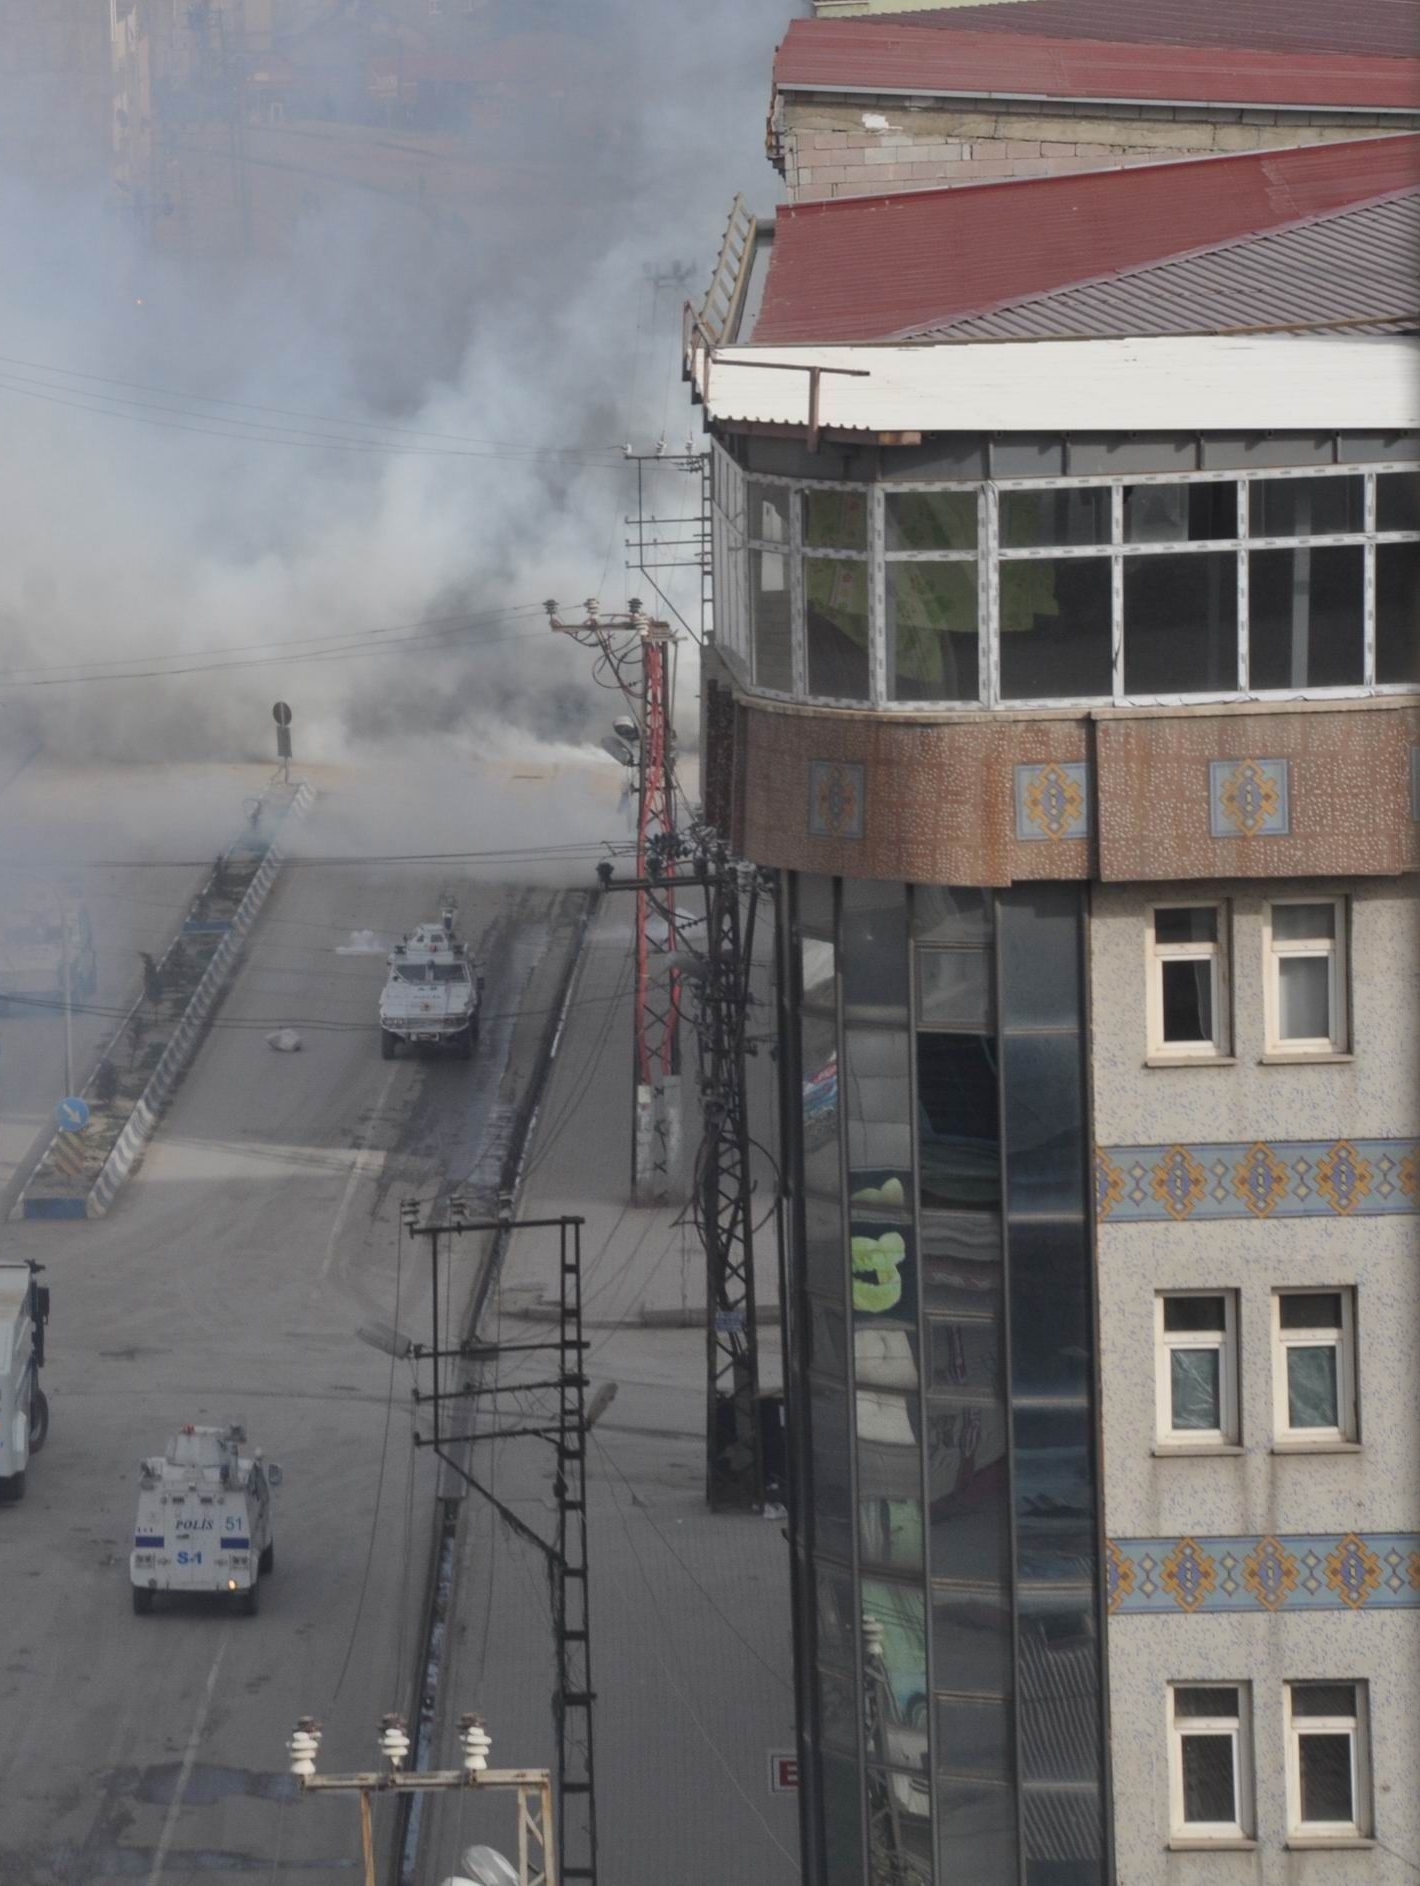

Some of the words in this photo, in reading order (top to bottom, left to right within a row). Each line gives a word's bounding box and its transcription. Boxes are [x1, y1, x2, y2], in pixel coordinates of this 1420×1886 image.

[175, 1518, 215, 1531] POLİS
[225, 1516, 242, 1531] 51
[177, 1551, 202, 1565] S-1
